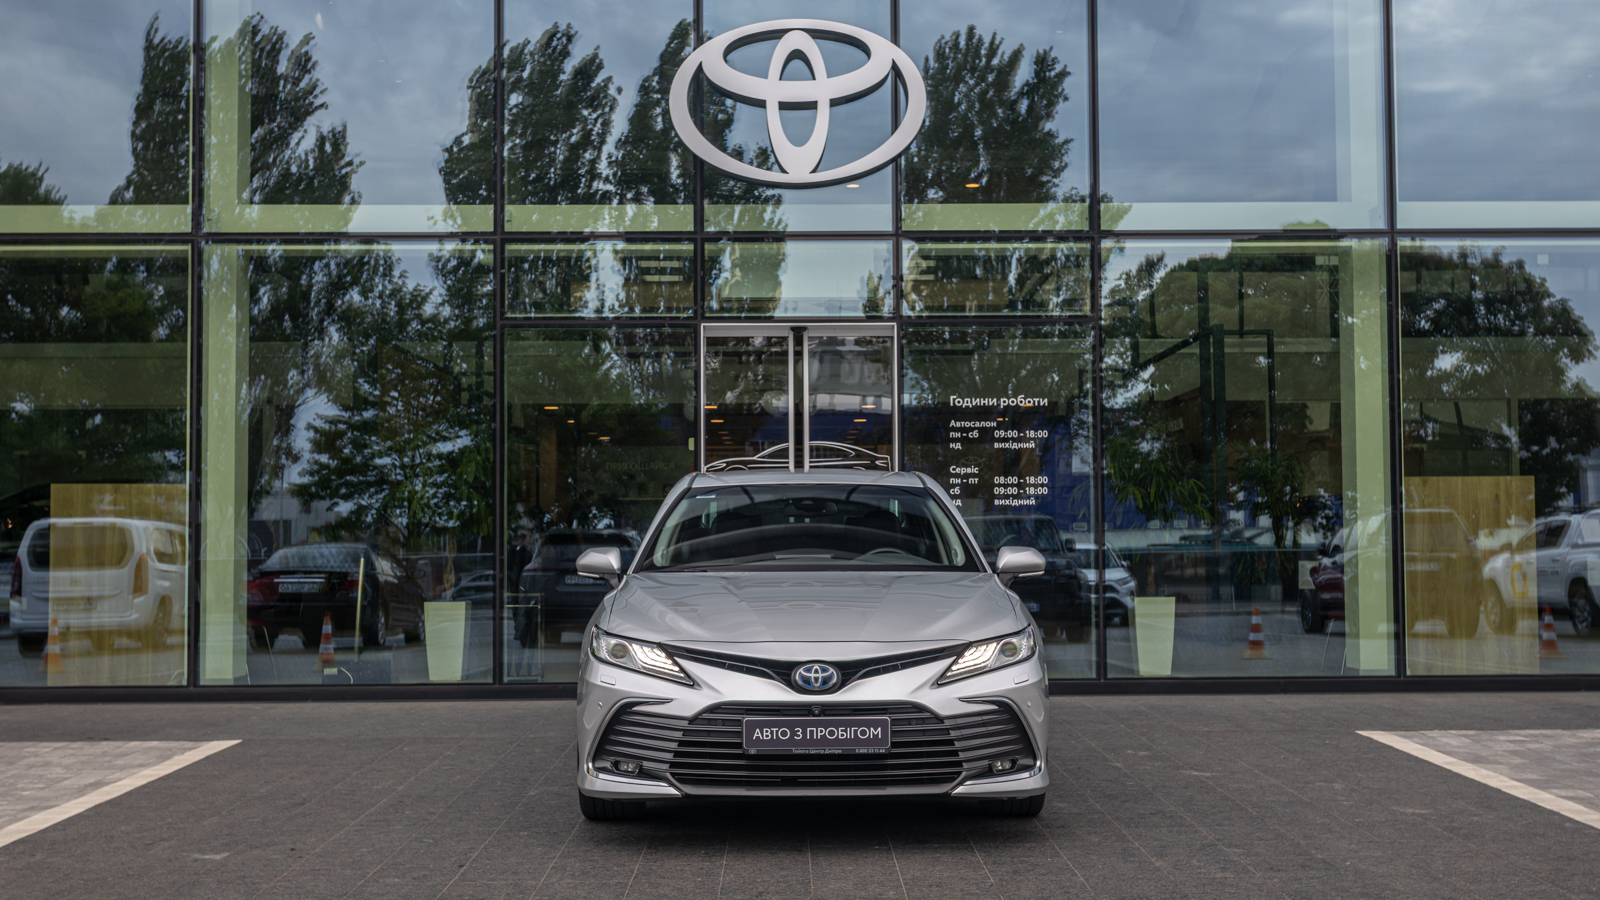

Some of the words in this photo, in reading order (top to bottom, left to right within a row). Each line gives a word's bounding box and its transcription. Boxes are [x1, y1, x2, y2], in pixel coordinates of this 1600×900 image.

[950, 395, 997, 408] Години
[1000, 394, 1048, 409] роботи
[950, 420, 997, 428] Автосалон
[968, 430, 979, 438] сб
[994, 430, 1018, 438] 09:00
[1025, 430, 1048, 438] 18:00
[950, 442, 962, 450] нд
[994, 440, 1035, 450] вихідний
[950, 465, 979, 475] Сервіс
[994, 476, 1018, 484] 08:00
[1025, 476, 1048, 484] 18:00
[950, 486, 960, 495] сб
[994, 487, 1018, 495] 09:00
[1025, 487, 1048, 495] 18:00
[994, 497, 1036, 507] вихідний
[753, 727, 791, 740] АВТО
[807, 726, 882, 740] ПРОБІГОМ
